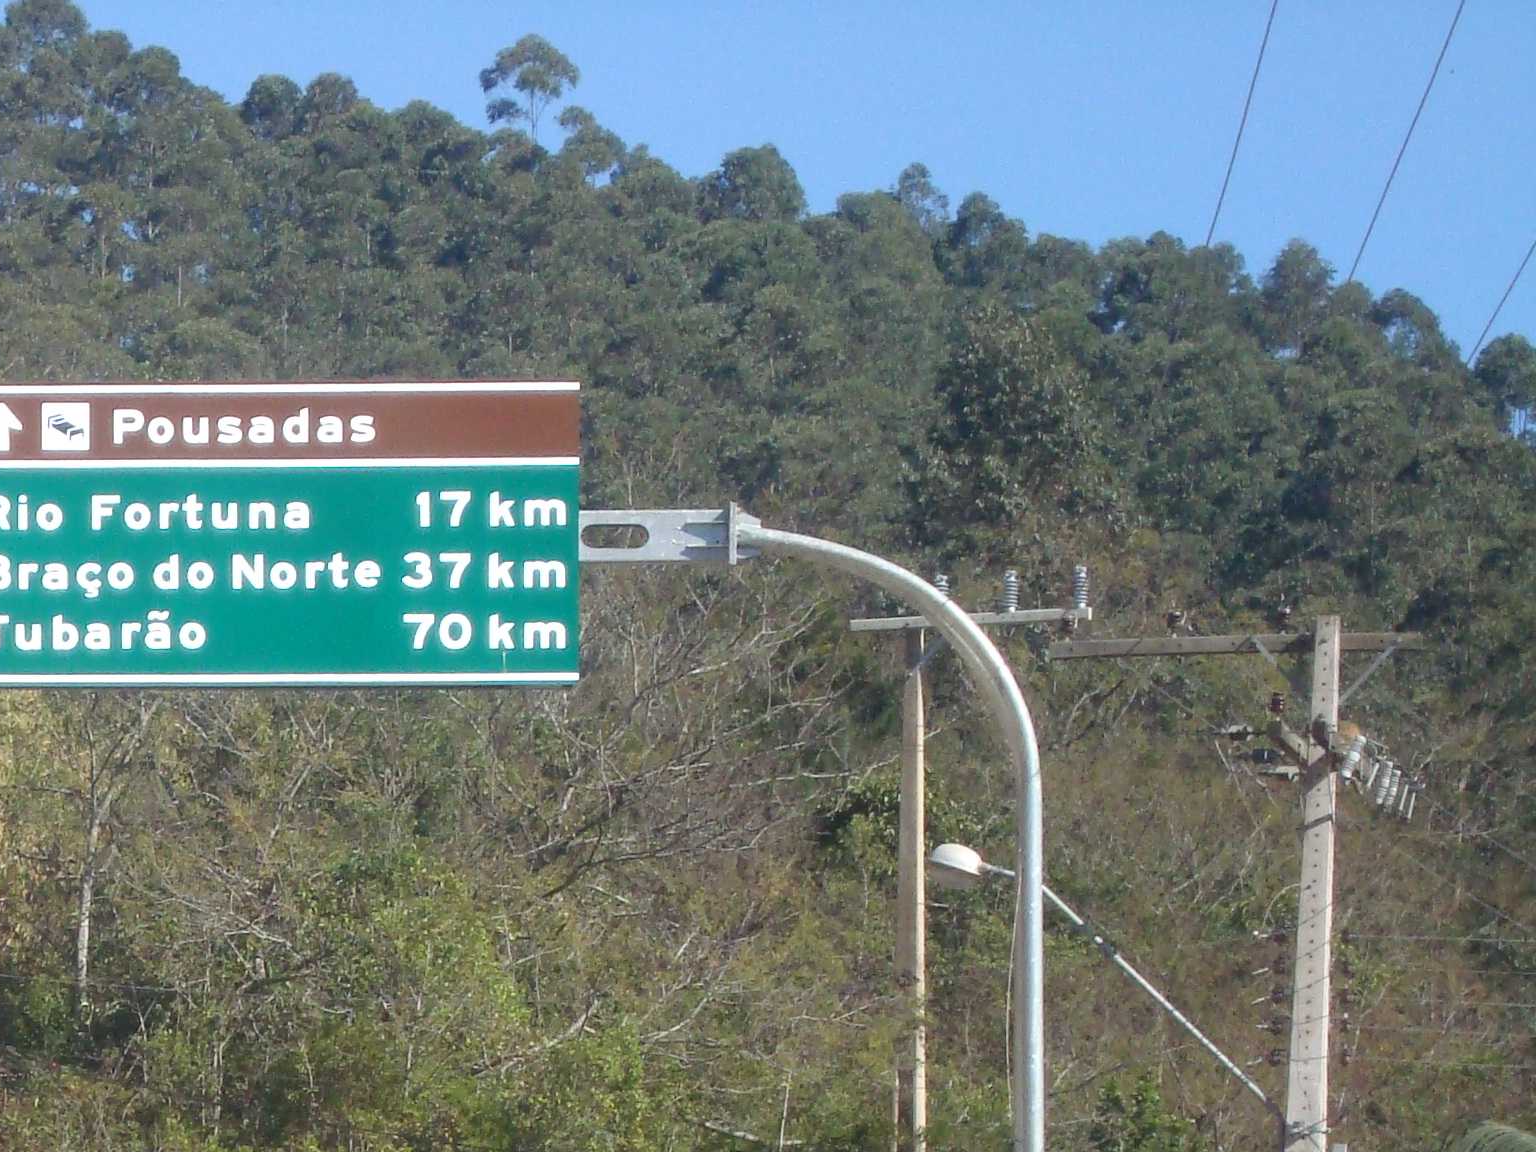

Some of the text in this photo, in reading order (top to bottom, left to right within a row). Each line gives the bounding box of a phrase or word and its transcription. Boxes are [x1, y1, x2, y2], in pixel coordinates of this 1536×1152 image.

[112, 407, 376, 448] Pousadas
[91, 493, 310, 531] Fortuna
[415, 490, 472, 528] 17
[488, 491, 568, 528] km
[152, 553, 215, 590] do
[231, 552, 381, 590] Norte
[401, 551, 472, 590] 37
[487, 552, 568, 590] km
[403, 612, 473, 651] 70
[487, 613, 568, 651] km
